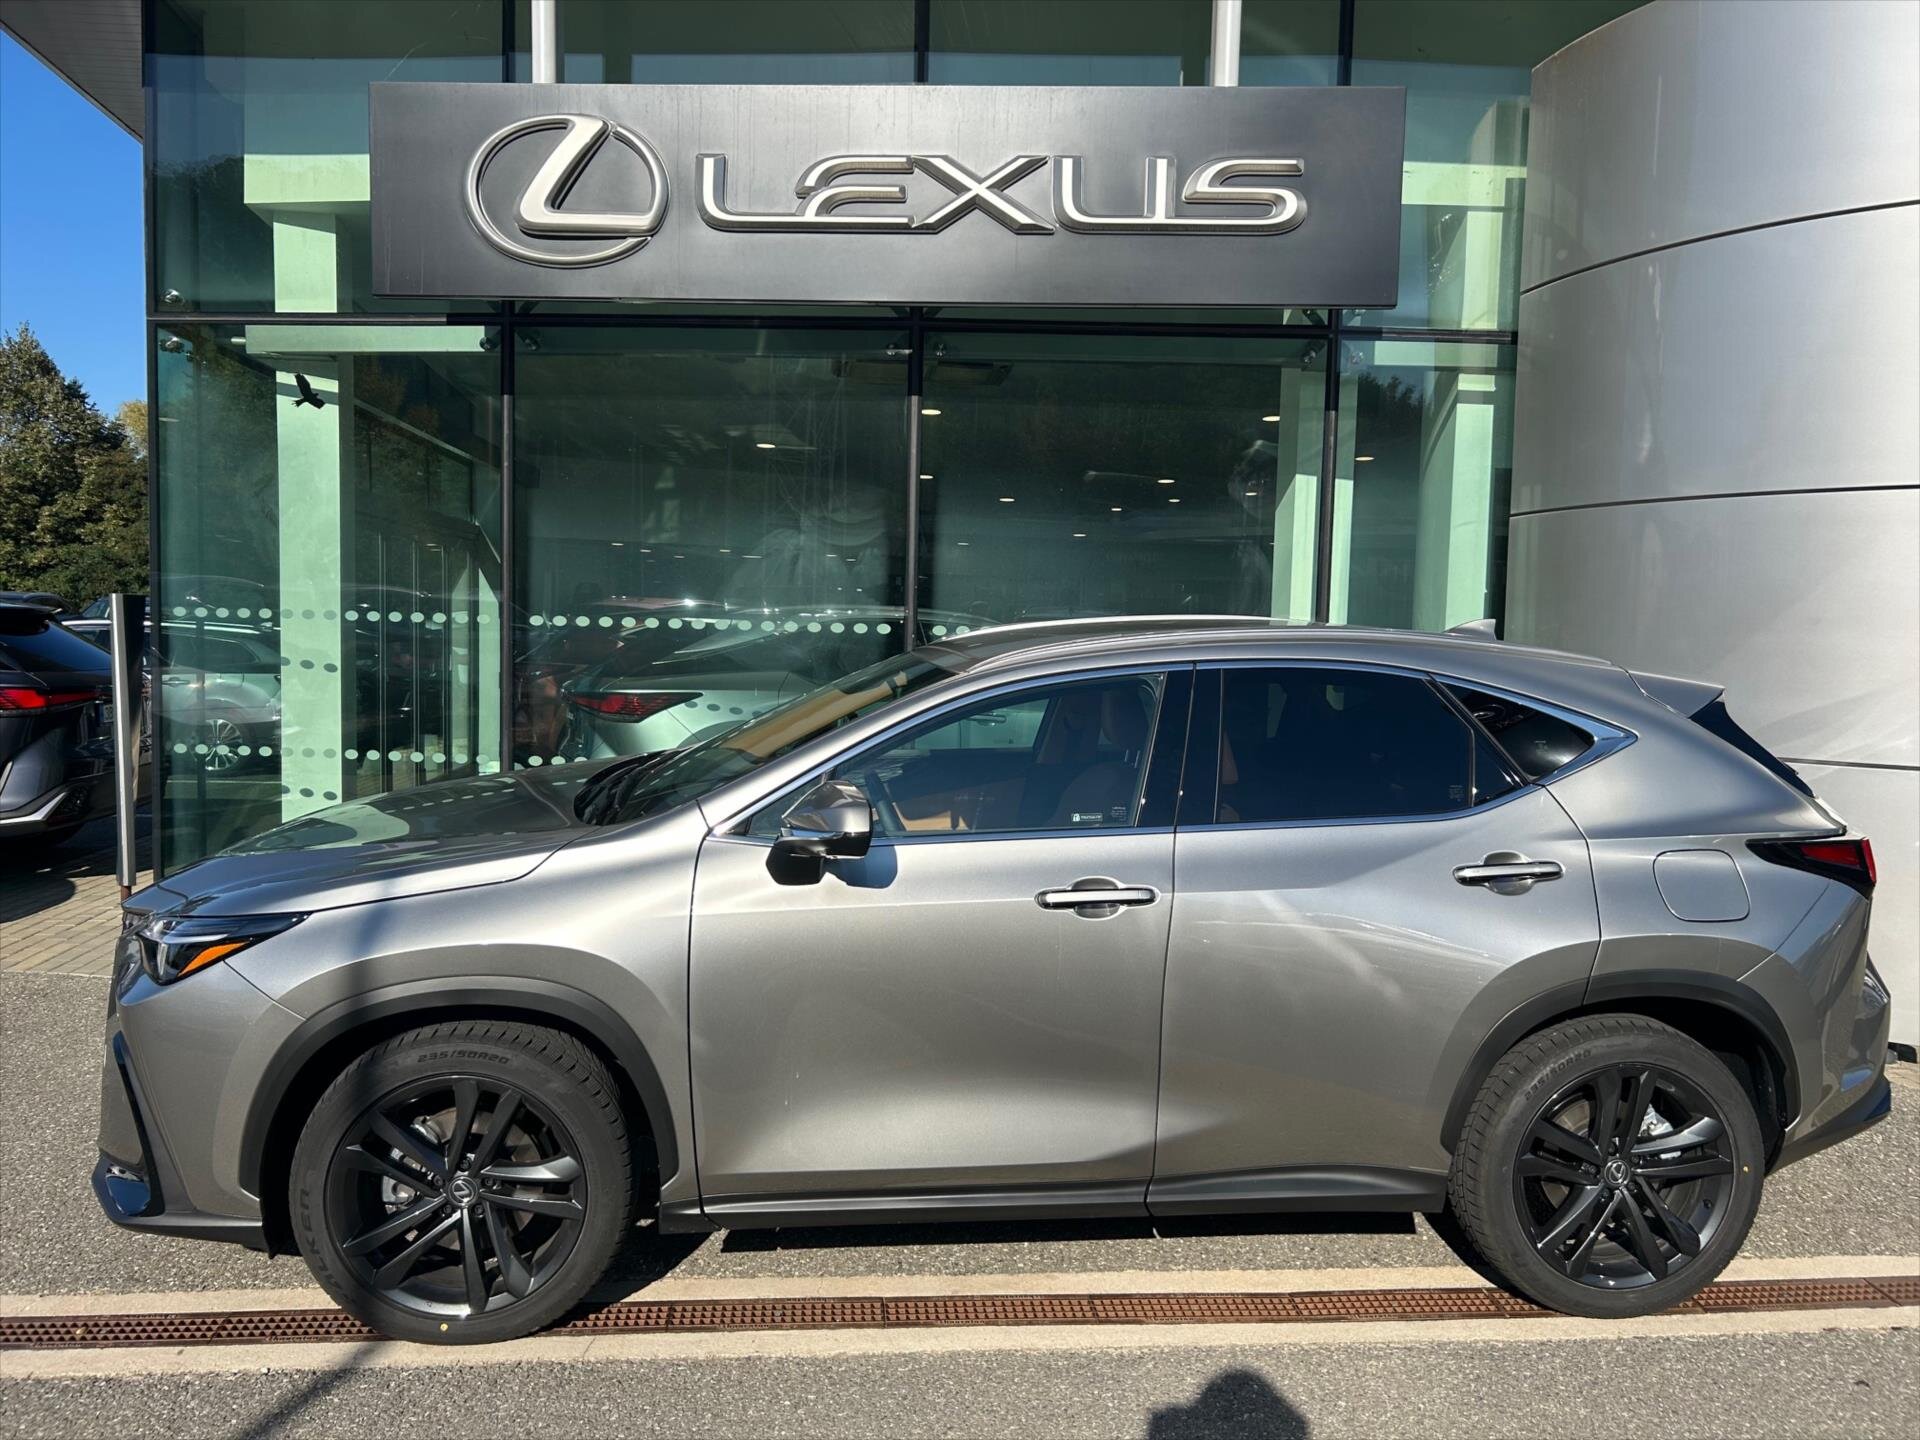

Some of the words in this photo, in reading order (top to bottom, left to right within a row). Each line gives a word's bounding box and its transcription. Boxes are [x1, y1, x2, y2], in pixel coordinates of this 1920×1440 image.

[696, 153, 1307, 235] LEXUS
[417, 1049, 511, 1065] 235/50R20
[300, 1188, 357, 1304] ALKEN
